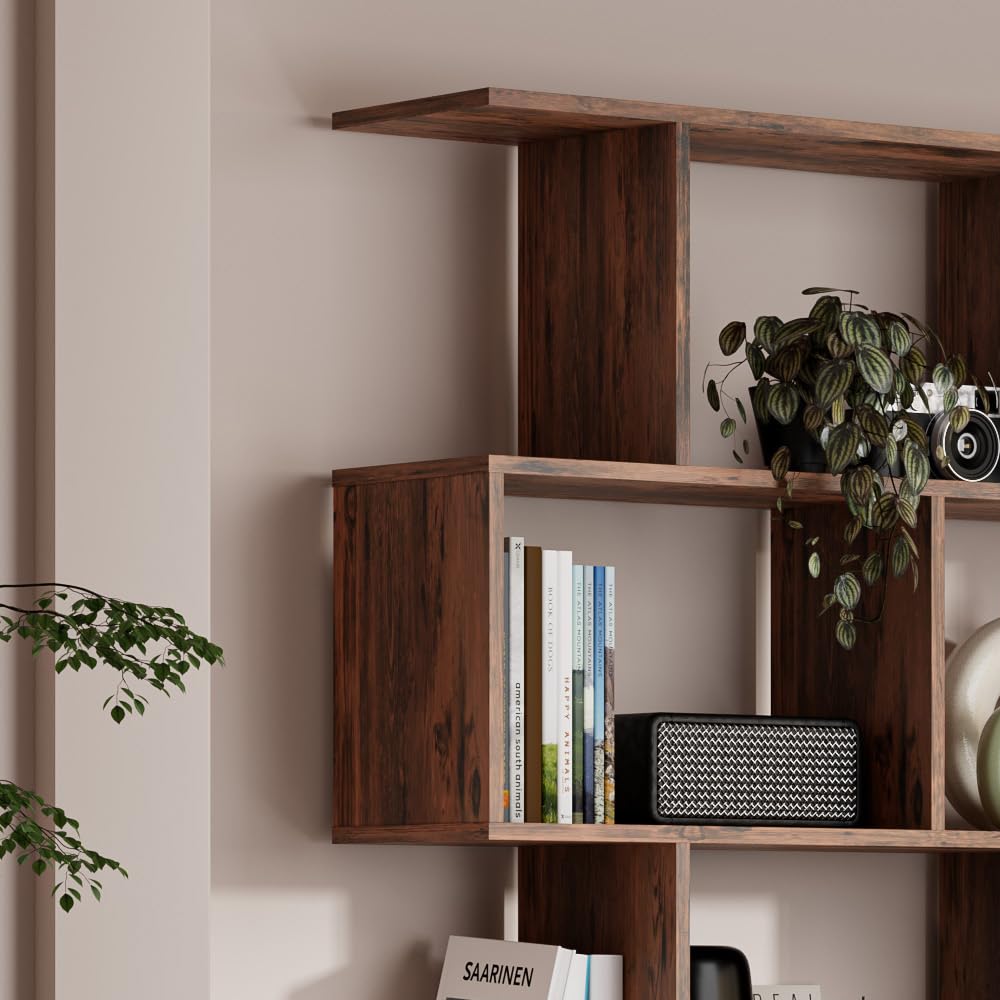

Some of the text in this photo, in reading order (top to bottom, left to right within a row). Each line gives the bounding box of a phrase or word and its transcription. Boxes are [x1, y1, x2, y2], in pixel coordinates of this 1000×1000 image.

[515, 682, 523, 818] american south animals
[463, 961, 534, 987] SAARINEN
